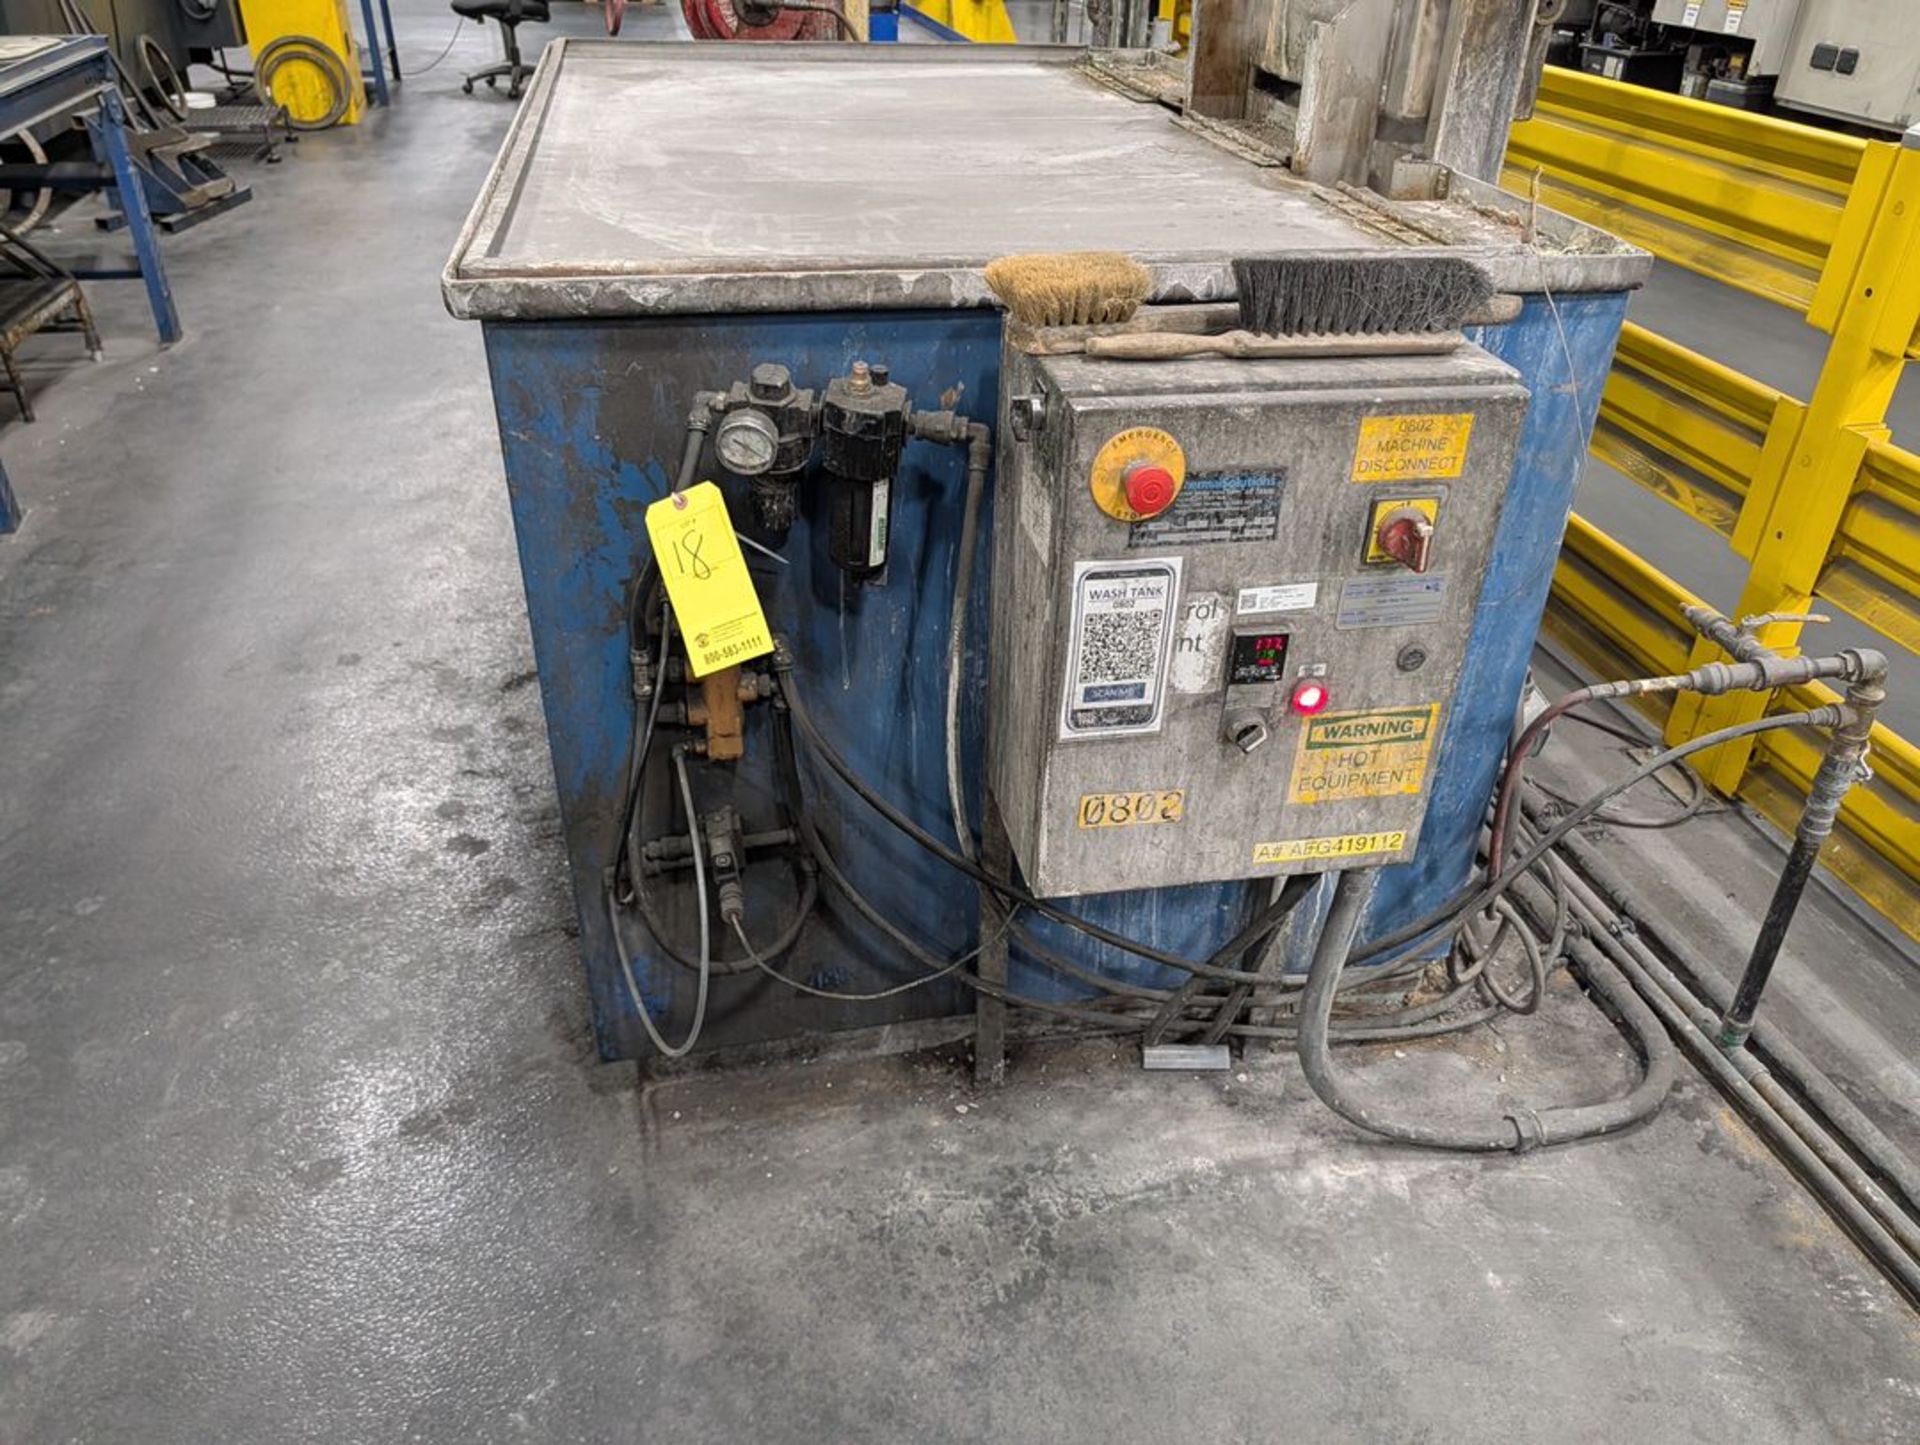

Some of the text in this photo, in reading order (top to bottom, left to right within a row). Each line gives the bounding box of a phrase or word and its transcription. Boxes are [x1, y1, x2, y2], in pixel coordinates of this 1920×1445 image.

[1398, 419, 1434, 433] 0802
[1112, 430, 1178, 453] EMERGENCY
[1377, 438, 1449, 452] MACHINE
[1357, 456, 1458, 473] DISCONNECT
[673, 529, 711, 580] 18
[1089, 586, 1163, 601] WASH TANK
[1091, 688, 1118, 699] SCAN
[1323, 719, 1414, 739] WARNING
[1338, 750, 1381, 768] HOT
[1298, 768, 1416, 791] EQUIPMENT
[1257, 845, 1281, 859] A#
